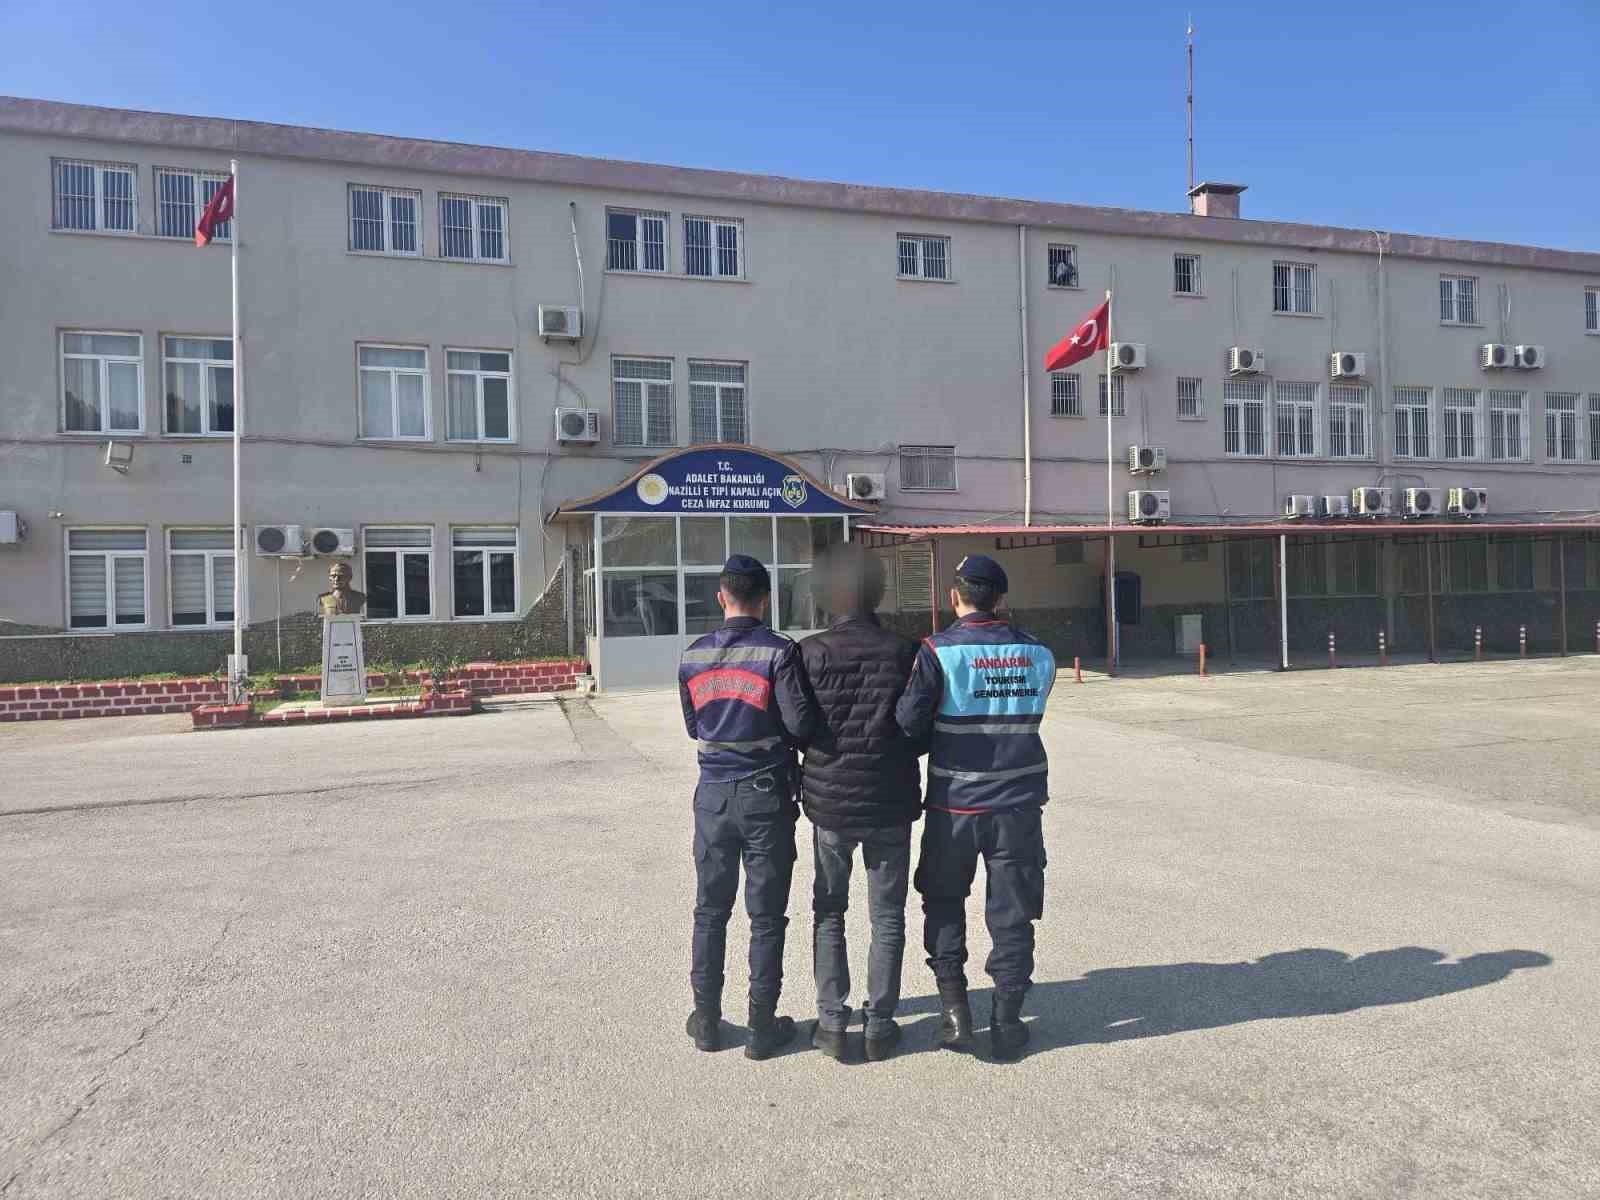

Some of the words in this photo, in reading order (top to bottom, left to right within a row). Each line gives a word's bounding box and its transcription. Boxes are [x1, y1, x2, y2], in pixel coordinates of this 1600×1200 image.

[717, 461, 734, 471] T.C.
[686, 473, 718, 483] ADALET
[720, 472, 765, 484] BAKANLIĞI
[703, 486, 709, 496] E
[681, 498, 704, 509] CEZA
[706, 497, 730, 509] İNFAZ
[733, 498, 770, 509] KURUMU
[971, 656, 1033, 669] JANDARMA
[984, 675, 1026, 685] TOURISM
[974, 687, 1039, 699] GENDARMERIE
